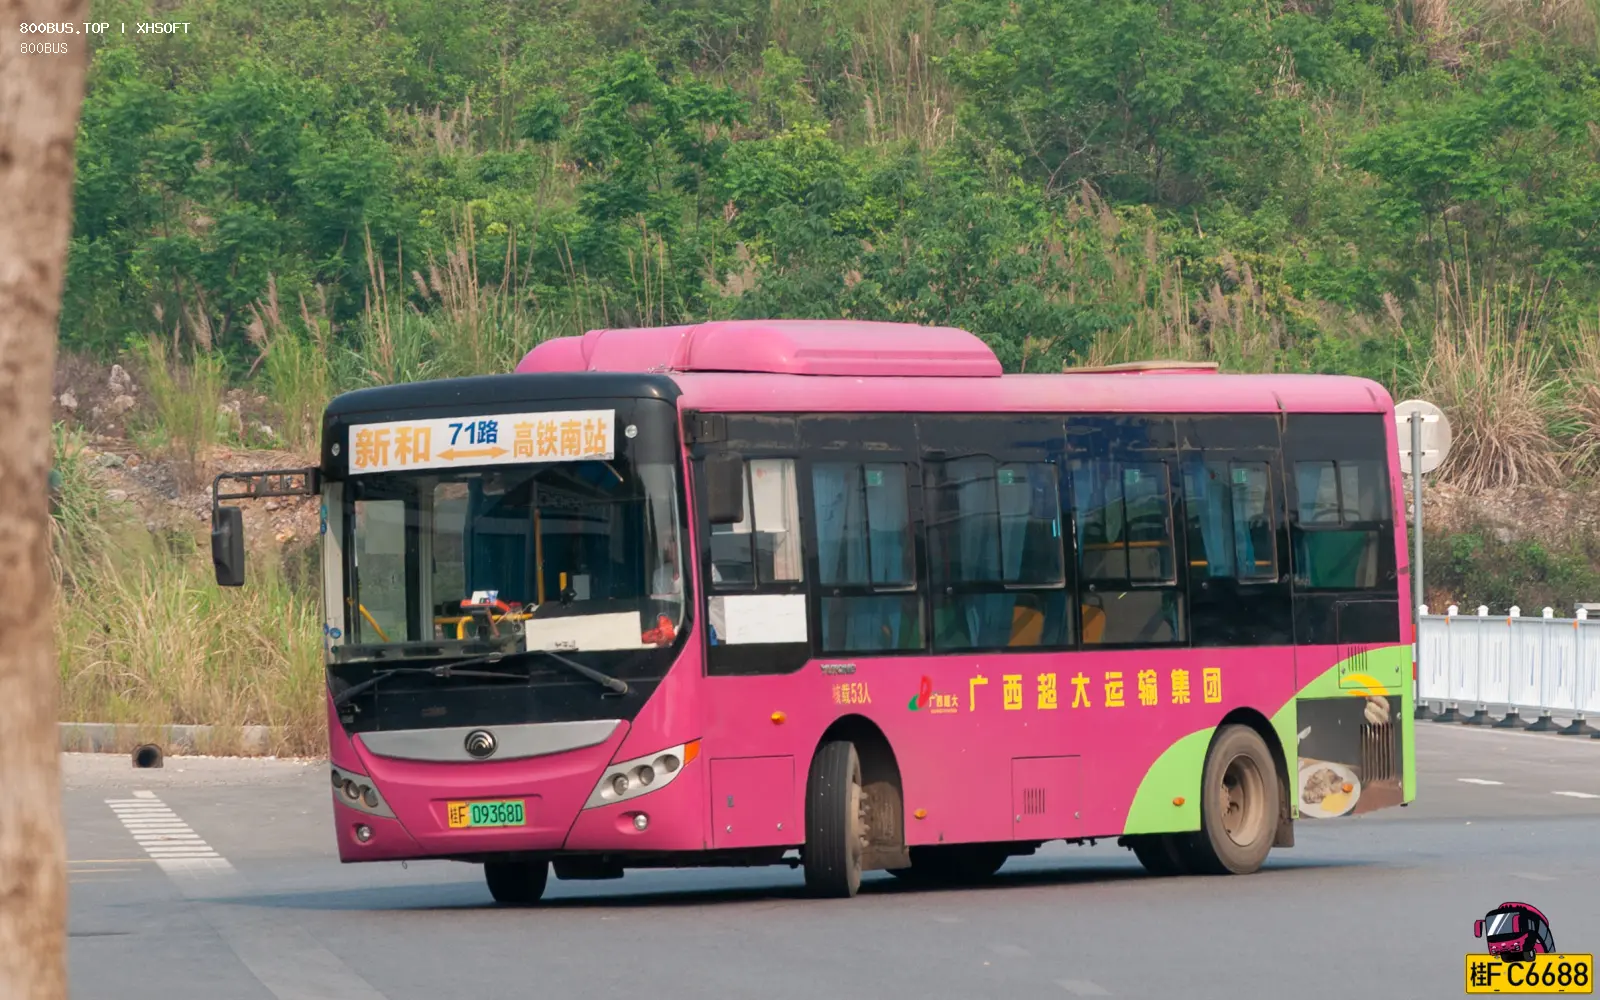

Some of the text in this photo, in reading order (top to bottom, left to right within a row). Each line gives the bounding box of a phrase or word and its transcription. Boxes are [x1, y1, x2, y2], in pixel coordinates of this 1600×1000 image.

[354, 417, 608, 469] 新和 71路 高铁南站
[968, 667, 1222, 712] 广西超大运输集团
